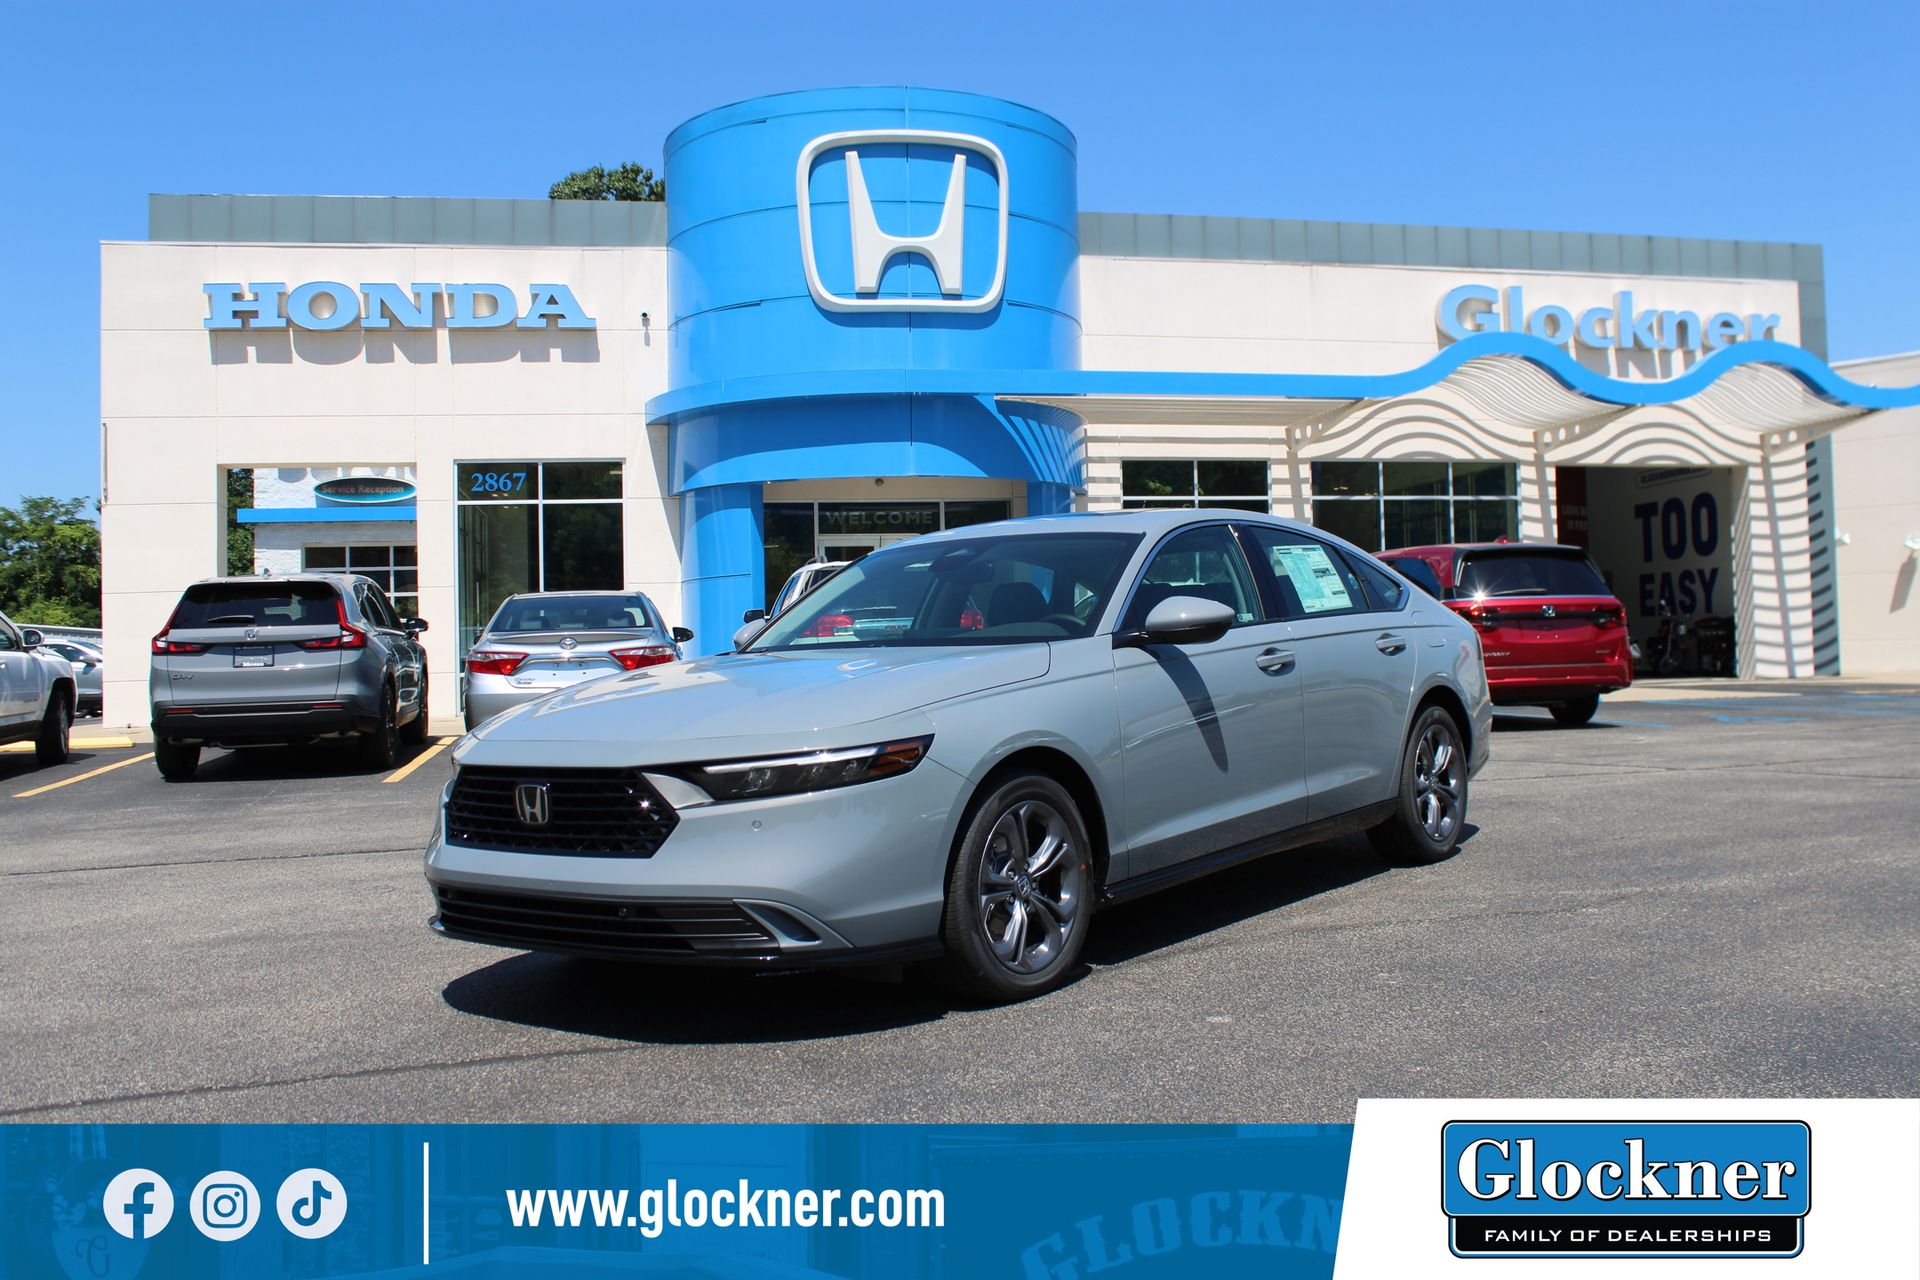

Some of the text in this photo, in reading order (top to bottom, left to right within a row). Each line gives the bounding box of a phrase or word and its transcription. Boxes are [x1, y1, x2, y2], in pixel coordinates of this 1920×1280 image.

[203, 281, 597, 330] HONDA
[1438, 284, 1781, 349] Glockner
[321, 484, 404, 496] Service Reception
[471, 472, 527, 492] 2867
[824, 511, 933, 525] WELCOME
[1634, 491, 1719, 564] TOO
[1639, 567, 1719, 617] EASY
